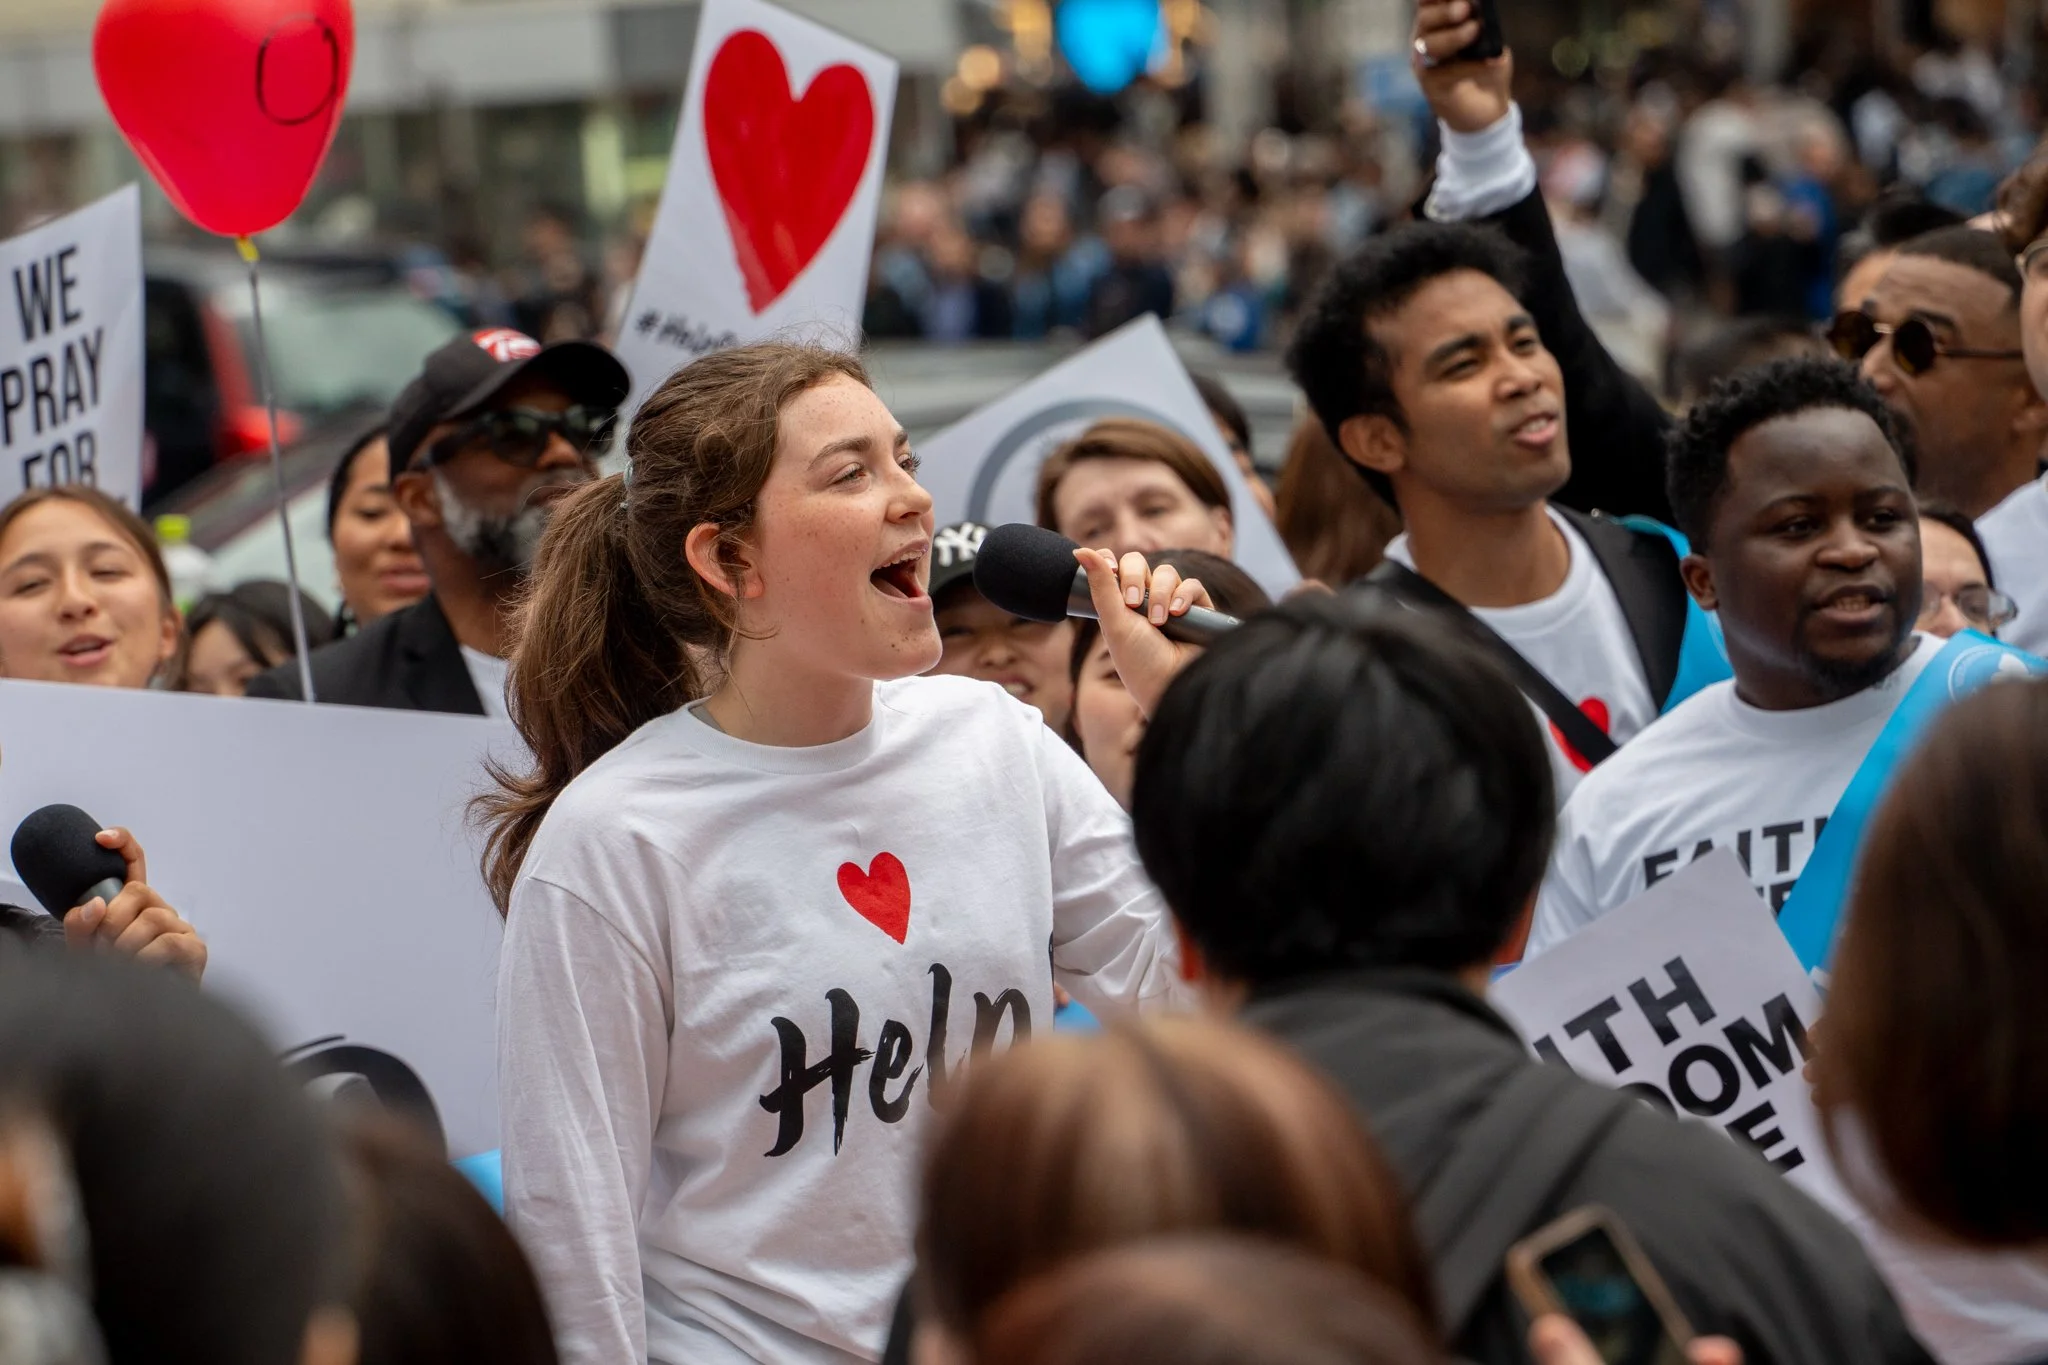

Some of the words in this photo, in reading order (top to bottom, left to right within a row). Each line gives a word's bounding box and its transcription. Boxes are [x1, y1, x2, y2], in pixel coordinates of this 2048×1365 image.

[12, 245, 82, 342] WE
[0, 327, 104, 446] PRAY
[1643, 816, 1829, 891] FIT
